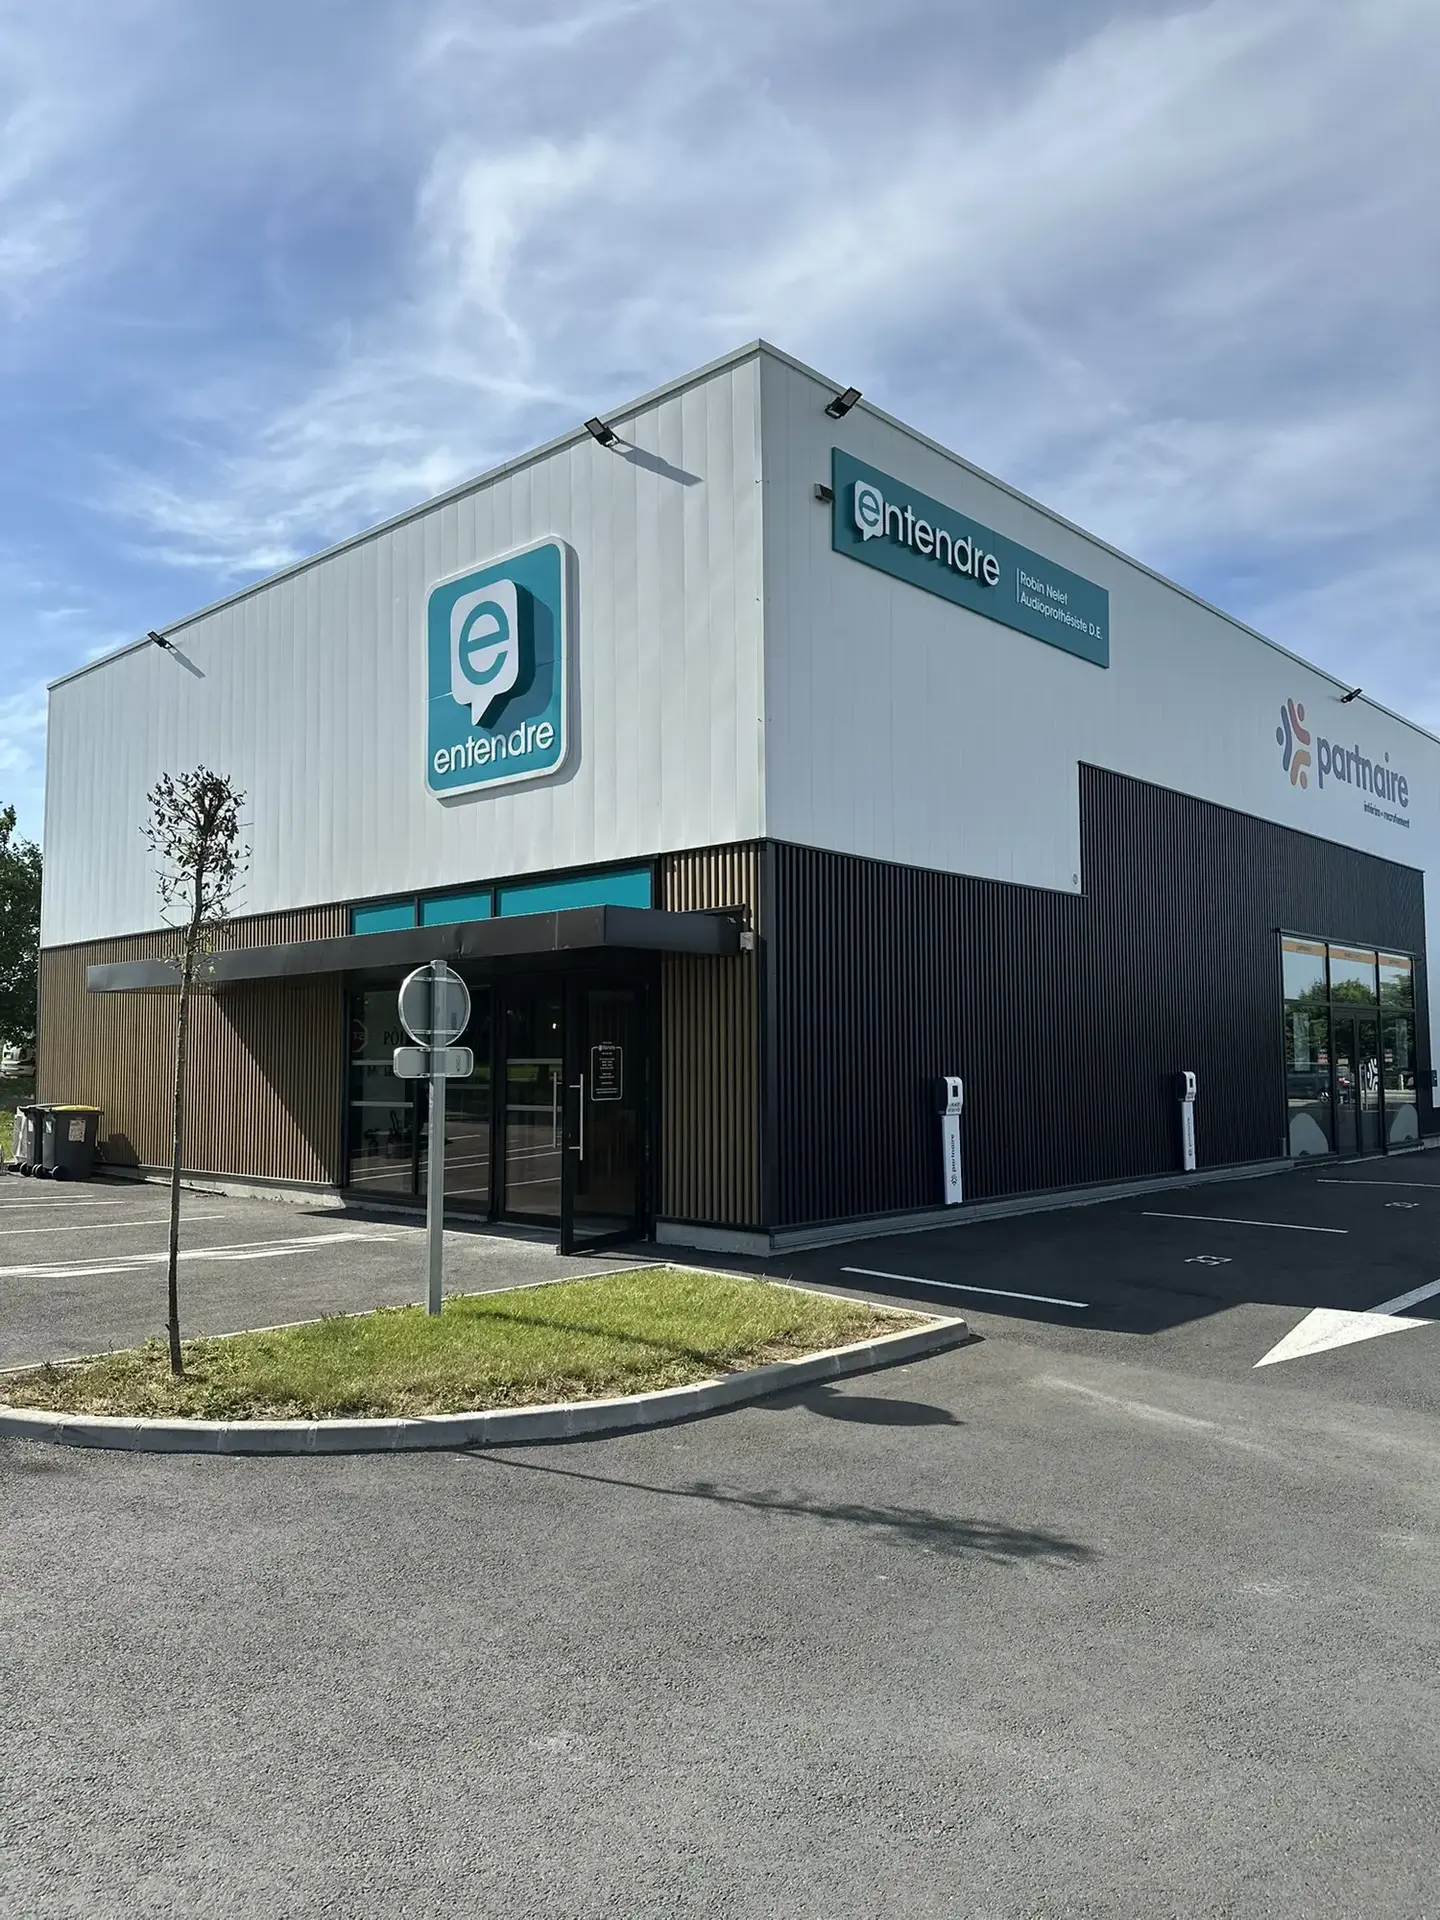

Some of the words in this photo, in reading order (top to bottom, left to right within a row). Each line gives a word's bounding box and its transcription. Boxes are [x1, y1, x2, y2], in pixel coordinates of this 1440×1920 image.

[857, 486, 1001, 586] entendre
[1020, 570, 1045, 595] Robin
[1046, 584, 1068, 605] Nelet
[1020, 591, 1088, 633] Audioprothésiste
[1088, 622, 1103, 640] D.E.
[433, 721, 555, 774] entendre
[1316, 736, 1409, 808] partnaire
